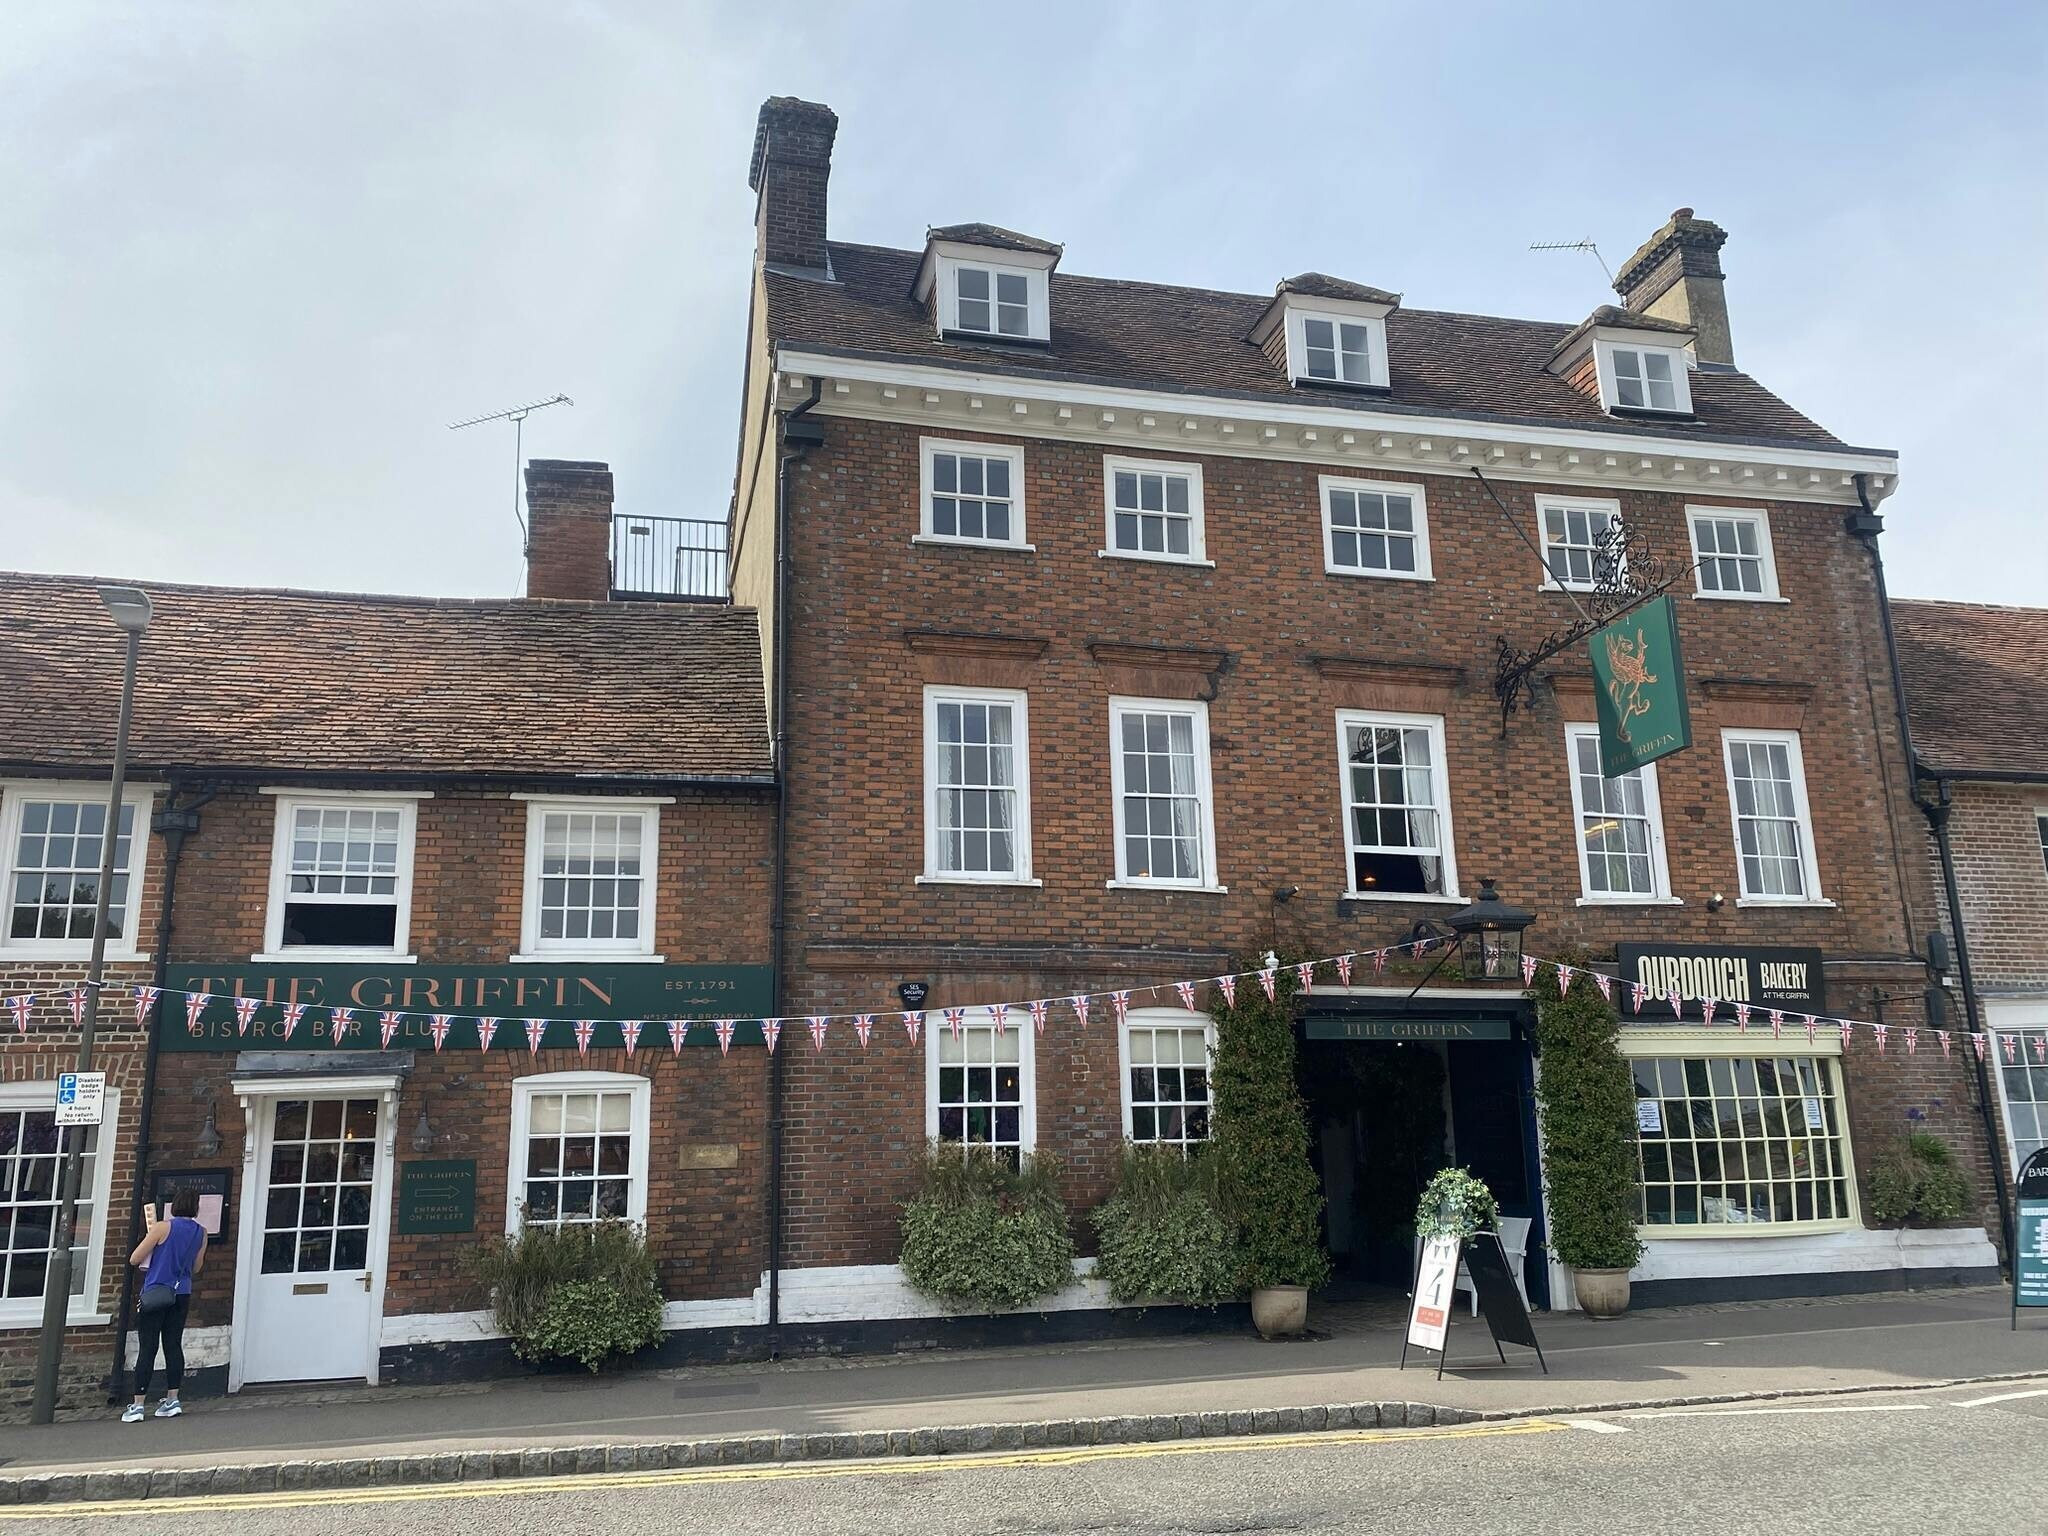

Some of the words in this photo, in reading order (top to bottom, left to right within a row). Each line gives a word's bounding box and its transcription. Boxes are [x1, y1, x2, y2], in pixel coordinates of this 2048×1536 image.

[1632, 734, 1674, 756] GRIFFIN
[1638, 955, 1750, 1001] OURDOUGH
[1760, 962, 1807, 990] BAKERY
[186, 977, 326, 1008] THE
[351, 976, 616, 1008] GRIFFIN
[700, 981, 736, 990] 1791
[1786, 992, 1810, 1000] GRIFFIN
[697, 1012, 754, 1020] BROADWAY
[192, 1021, 287, 1038] BISRO
[1344, 1023, 1385, 1036] THE
[1391, 1023, 1473, 1036] GRIFFIN
[415, 1205, 459, 1213] ENTRANCE
[444, 1212, 464, 1220] LEFT
